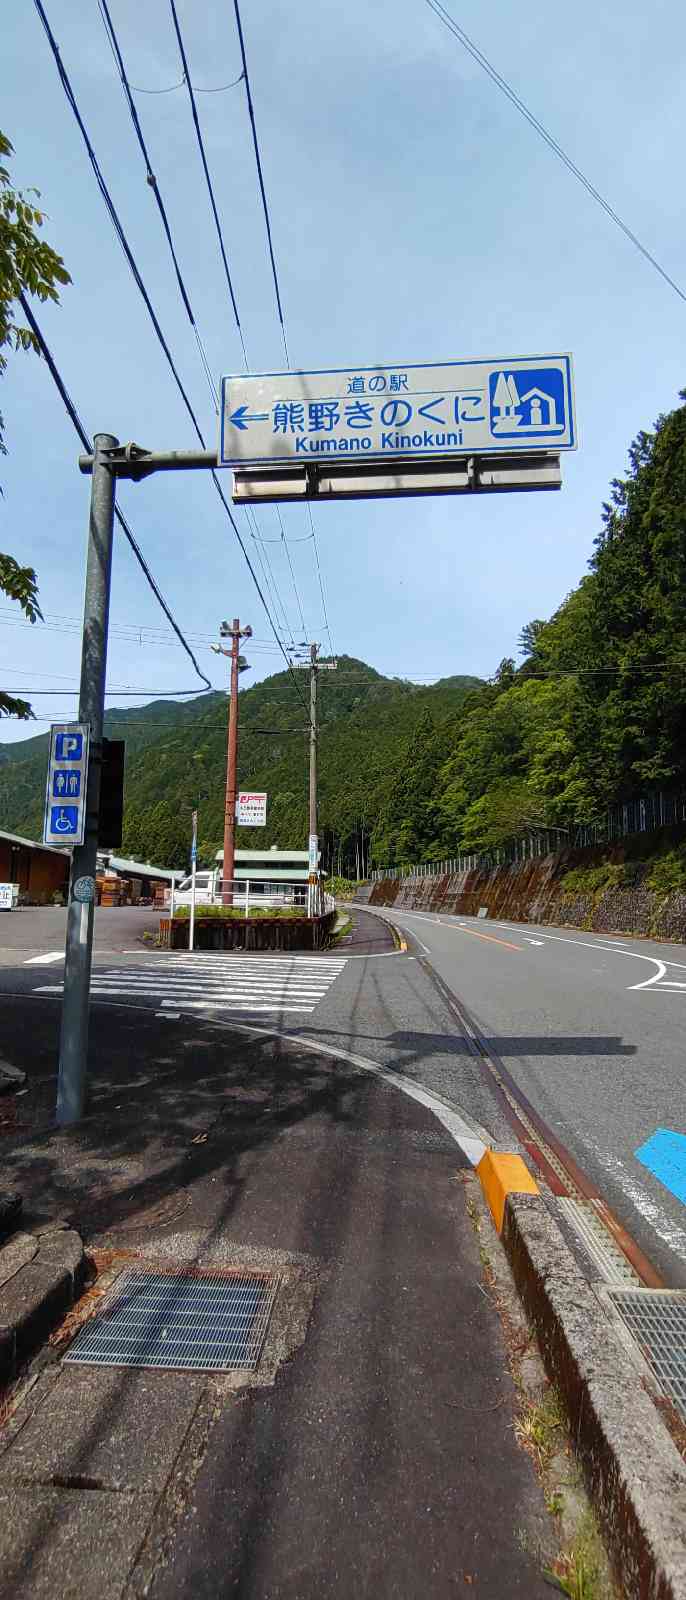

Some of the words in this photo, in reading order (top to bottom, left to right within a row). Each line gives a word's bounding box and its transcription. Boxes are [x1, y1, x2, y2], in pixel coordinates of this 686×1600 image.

[347, 374, 408, 394] 道の駅
[271, 395, 486, 434] 熊野きのくに
[295, 435, 372, 453] Kumano
[381, 429, 463, 449] Kinokuni
[62, 737, 78, 758] P
